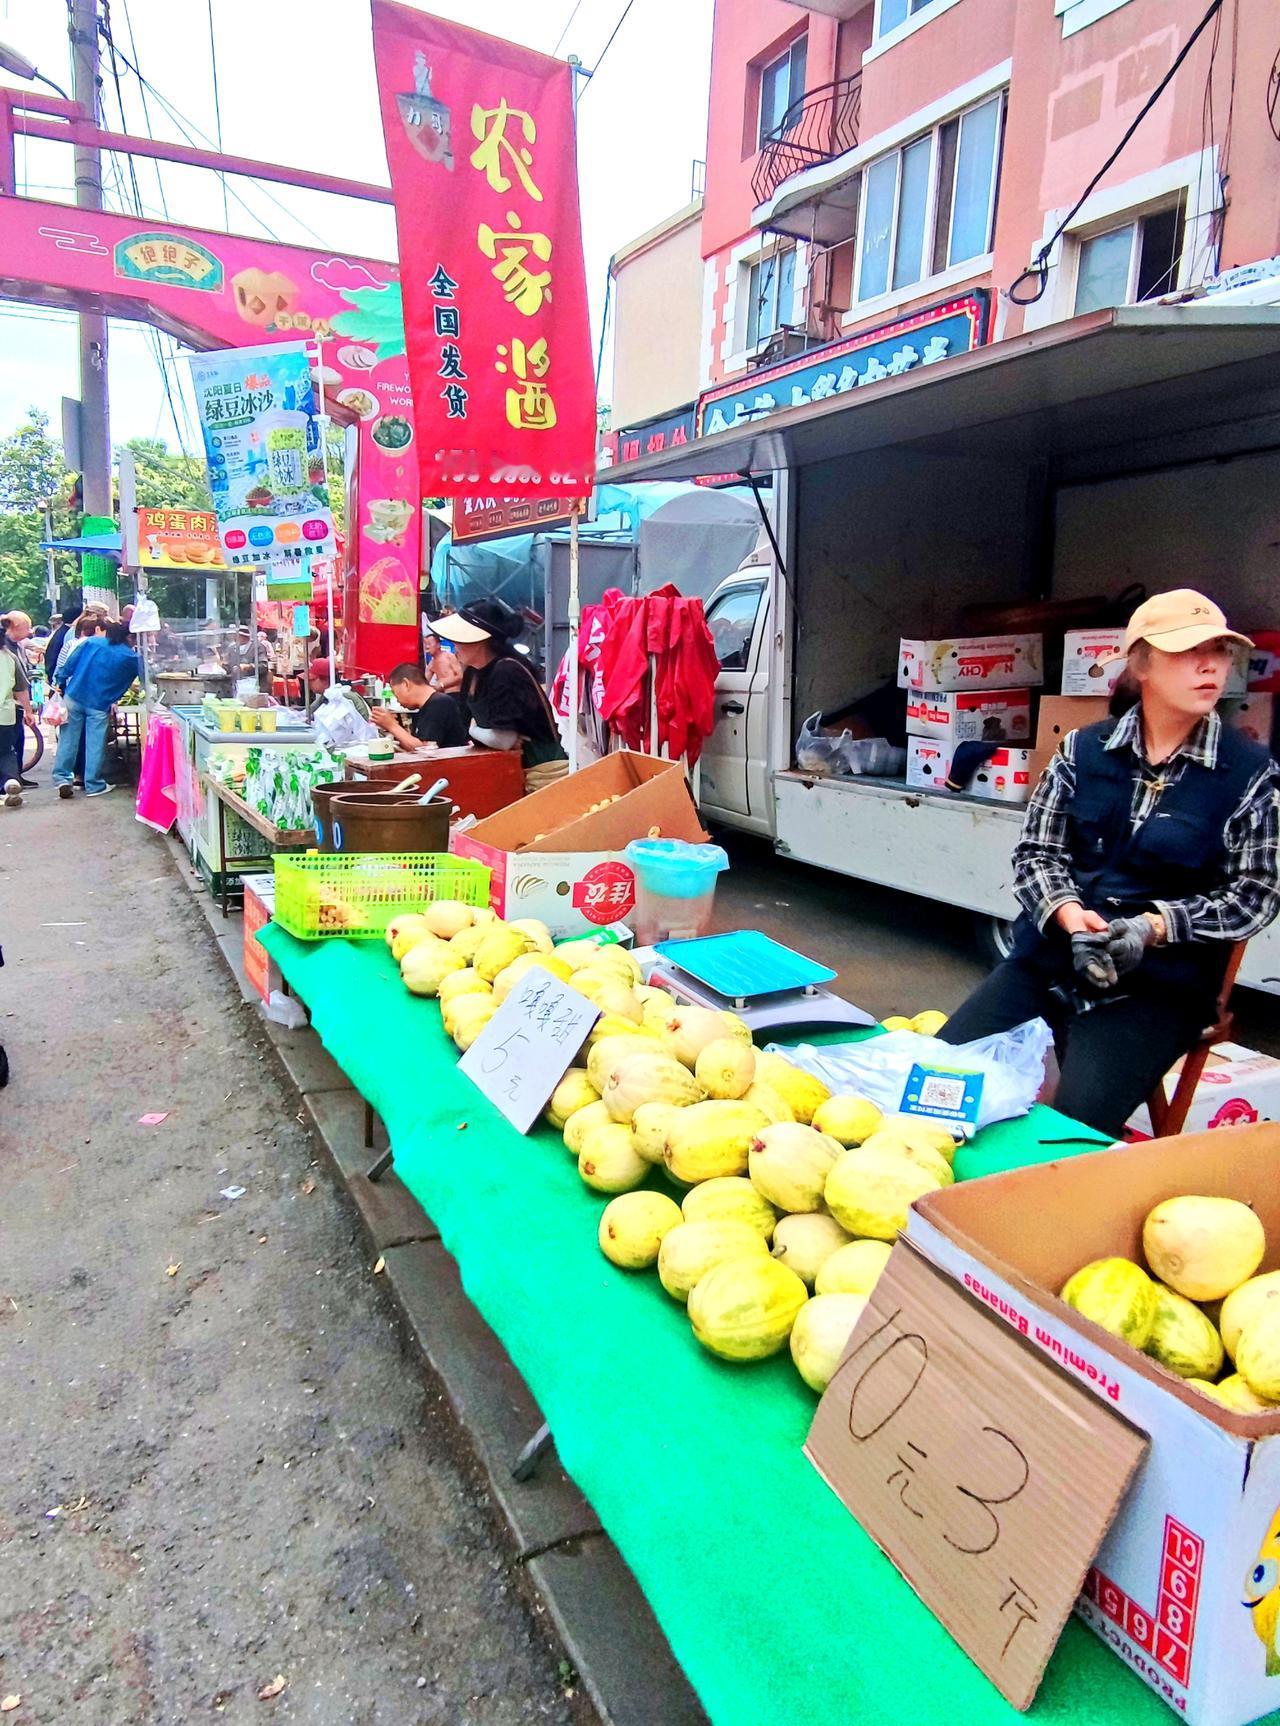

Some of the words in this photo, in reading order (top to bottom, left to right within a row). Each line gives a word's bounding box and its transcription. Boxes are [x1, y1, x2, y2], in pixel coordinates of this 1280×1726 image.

[140, 244, 201, 269] 绝绝子
[468, 96, 558, 431] 农家酱
[427, 262, 467, 419] 全国发货
[204, 382, 242, 398] 沈阳夏日
[205, 389, 274, 421] 绿豆冰沙
[584, 880, 634, 907] 佳农
[963, 1272, 1029, 1336] Bananas
[1035, 1326, 1120, 1402] Premium
[1170, 1569, 1188, 1600] 9
[1132, 1612, 1149, 1642] 6
[1166, 1603, 1185, 1635] 8
[1098, 1619, 1188, 1713] PRODUCT
[1161, 1644, 1179, 1674] 7
